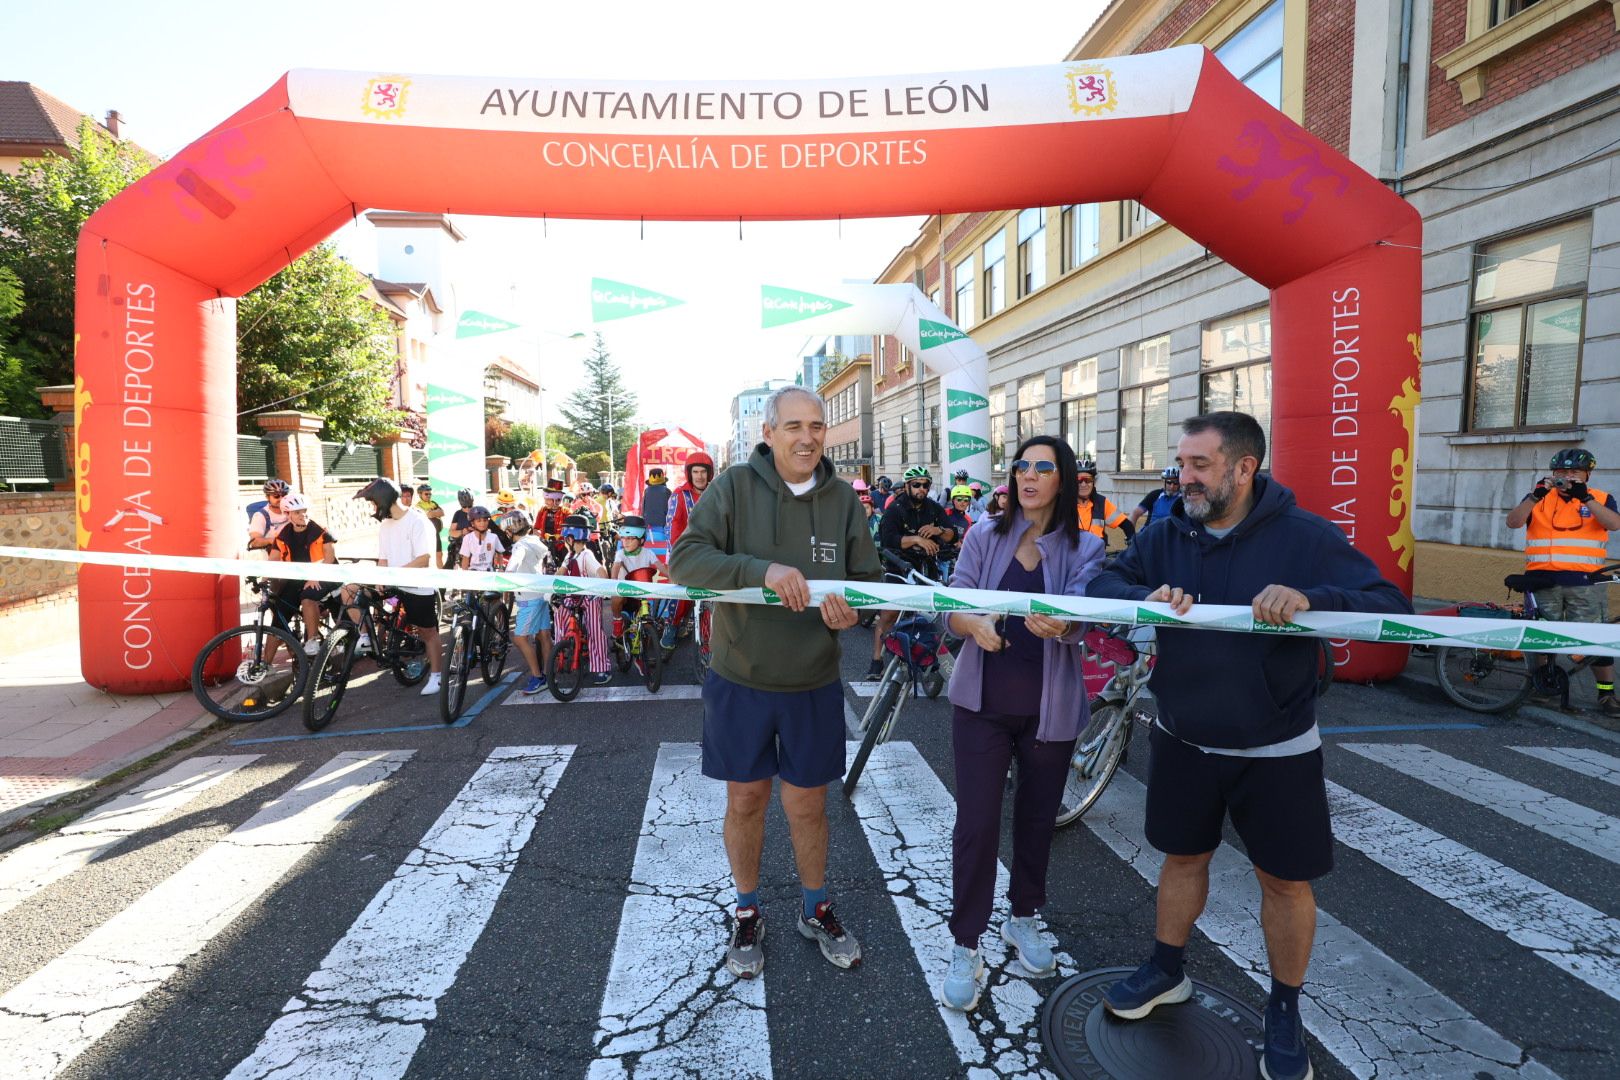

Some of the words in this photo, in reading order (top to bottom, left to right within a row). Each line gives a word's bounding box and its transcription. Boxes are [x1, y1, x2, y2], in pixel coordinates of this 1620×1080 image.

[480, 88, 803, 120] AYUNTAMIENTO
[818, 89, 869, 118] DE
[884, 79, 990, 116] LEÓN
[542, 137, 720, 172] CONCEJALÍA
[730, 144, 769, 169] DE
[780, 139, 928, 169] DEPORTES
[123, 282, 156, 436] DEPORTES
[1332, 286, 1360, 437] DEPORTES
[123, 440, 152, 477] DE
[642, 445, 697, 465] IRC
[1331, 449, 1358, 486] DE
[1063, 991, 1104, 1080] TAMIENTO
